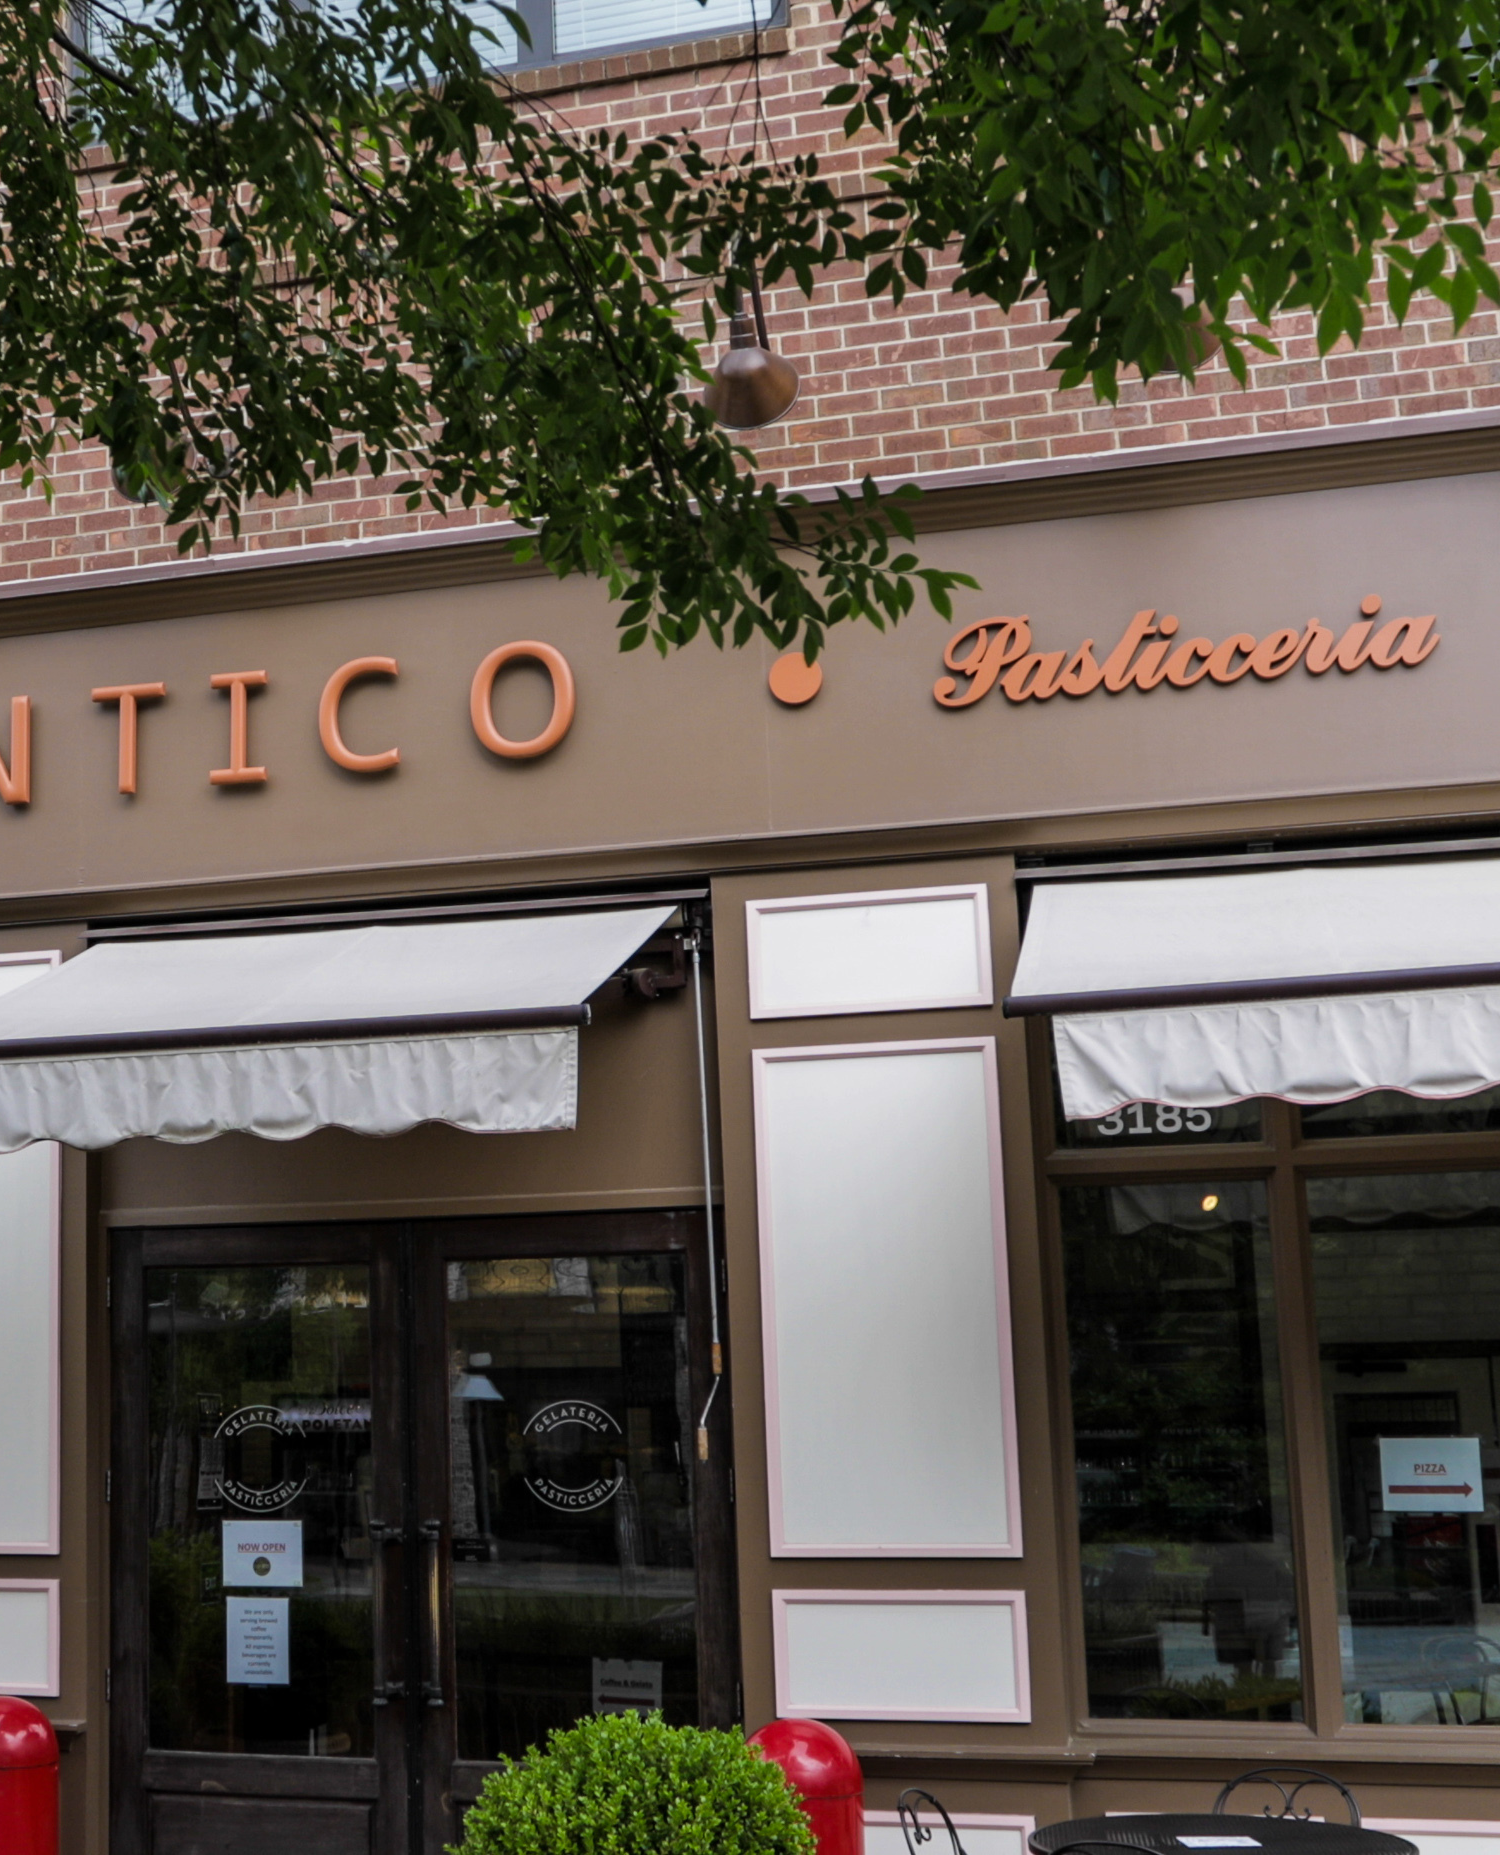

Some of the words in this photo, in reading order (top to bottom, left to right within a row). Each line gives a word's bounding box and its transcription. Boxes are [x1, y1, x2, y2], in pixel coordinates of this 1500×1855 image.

[932, 593, 1441, 708] Pasticceria
[1097, 1101, 1212, 1136] 3185
[224, 1410, 294, 1437] GELATERIA
[534, 1406, 609, 1433] GELATERIA
[1414, 1463, 1447, 1474] PIZZA
[224, 1480, 299, 1506] PASTICCERIA
[534, 1477, 615, 1505] PASTICCERIA
[237, 1543, 260, 1552] NOW
[262, 1543, 286, 1552] OPEN
